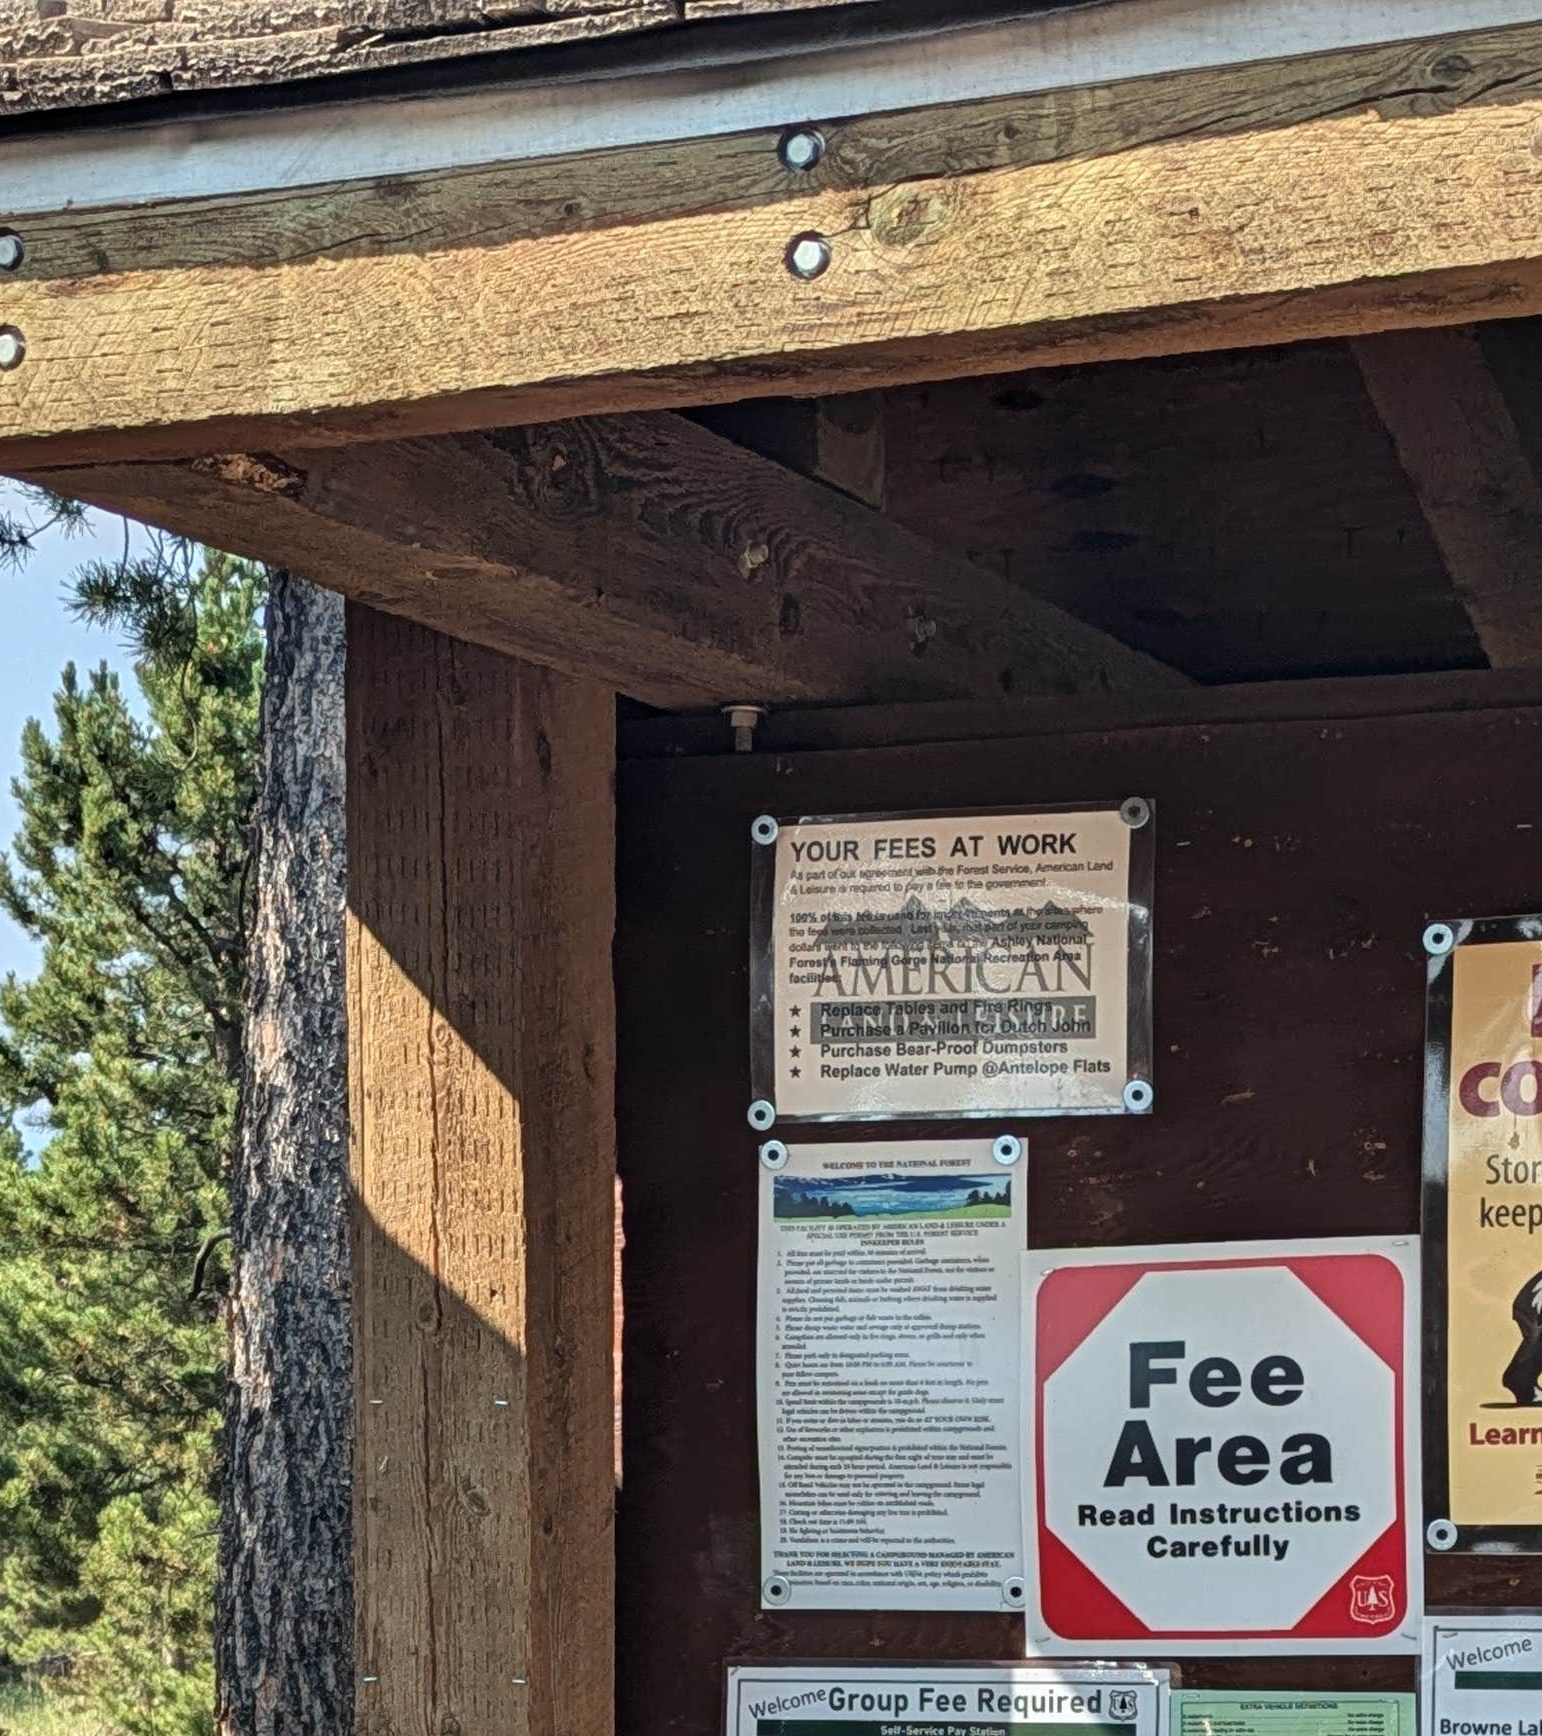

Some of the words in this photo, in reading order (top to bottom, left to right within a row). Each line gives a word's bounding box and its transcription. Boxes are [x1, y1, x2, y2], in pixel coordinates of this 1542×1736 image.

[790, 841, 860, 862] YOUR
[874, 837, 937, 860] FEES
[950, 836, 984, 857] AT
[997, 833, 1077, 855] WORK
[957, 864, 989, 875] Forest
[991, 863, 1033, 875] Service,
[1035, 862, 1084, 873] American
[1087, 860, 1113, 871] Land
[811, 943, 1096, 997] AMERICAN
[820, 1003, 881, 1020] Replace
[887, 1001, 935, 1016] Tables
[939, 1001, 968, 1015] and
[973, 1000, 1002, 1013] Fire
[1007, 999, 1052, 1015] Rings
[820, 1024, 891, 1038] Purchase
[896, 1026, 905, 1036] a
[909, 1021, 970, 1036] Pavilion
[1001, 1021, 1047, 1034] Dutch
[1052, 1018, 1091, 1033] John
[820, 1044, 891, 1058] Purchase
[896, 1040, 978, 1056] Bear-Proof
[983, 1041, 1068, 1057] Dumpsters
[820, 1064, 881, 1081] Replace
[885, 1063, 929, 1077] Water
[933, 1062, 977, 1078] Pump
[982, 1060, 1069, 1078] @Antelope
[1073, 1059, 1111, 1074] Flats
[1129, 1340, 1304, 1409] Fee
[1103, 1419, 1333, 1488] Area
[1077, 1503, 1155, 1527] Read
[1170, 1501, 1361, 1526] Instructions
[1146, 1534, 1289, 1561] Carefully
[1446, 1636, 1533, 1671] Welcome
[748, 1688, 827, 1720] Welcome
[828, 1687, 908, 1718] Group
[919, 1687, 967, 1712] Fee
[977, 1688, 1102, 1718] Required
[880, 1725, 944, 1736] Self-Service
[969, 1726, 1005, 1736] Station
[1440, 1718, 1512, 1736] Browne
